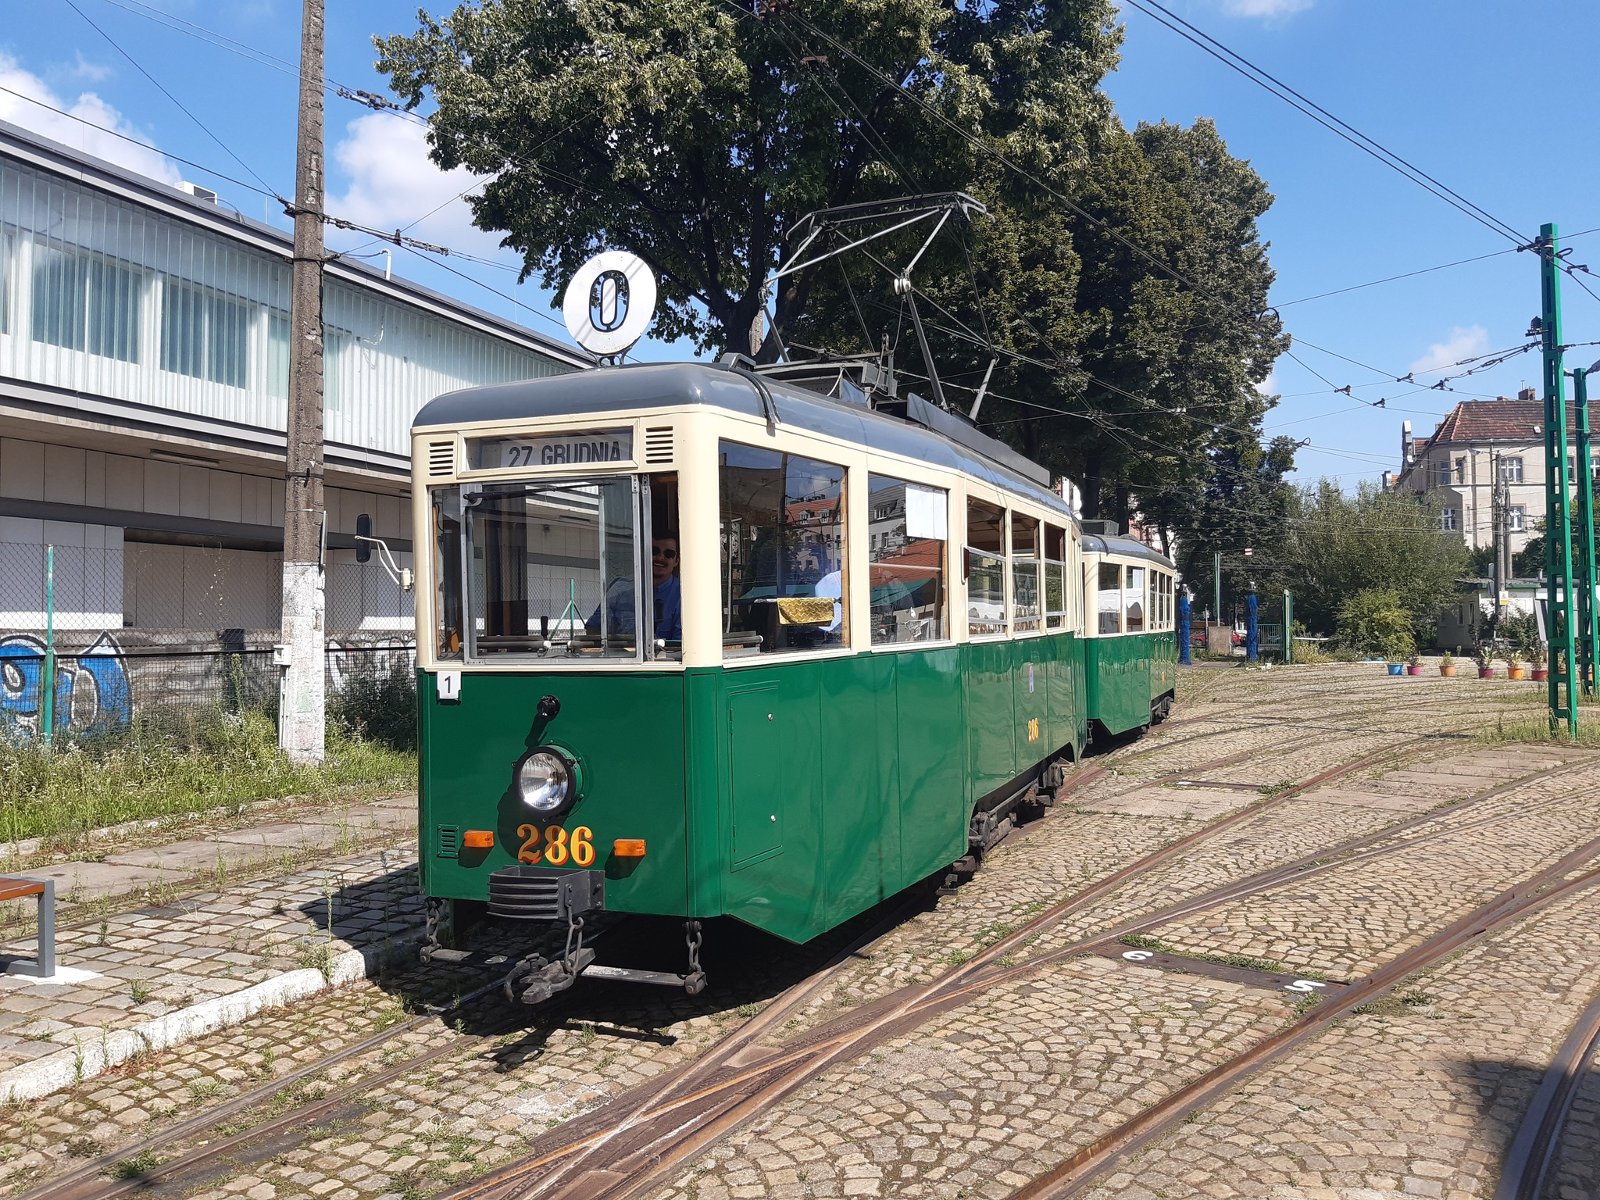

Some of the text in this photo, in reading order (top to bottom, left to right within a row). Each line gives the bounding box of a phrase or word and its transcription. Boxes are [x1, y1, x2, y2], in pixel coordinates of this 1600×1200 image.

[508, 440, 621, 468] 27 GRUDNIA
[444, 675, 451, 694] 1
[516, 823, 596, 867] 286
